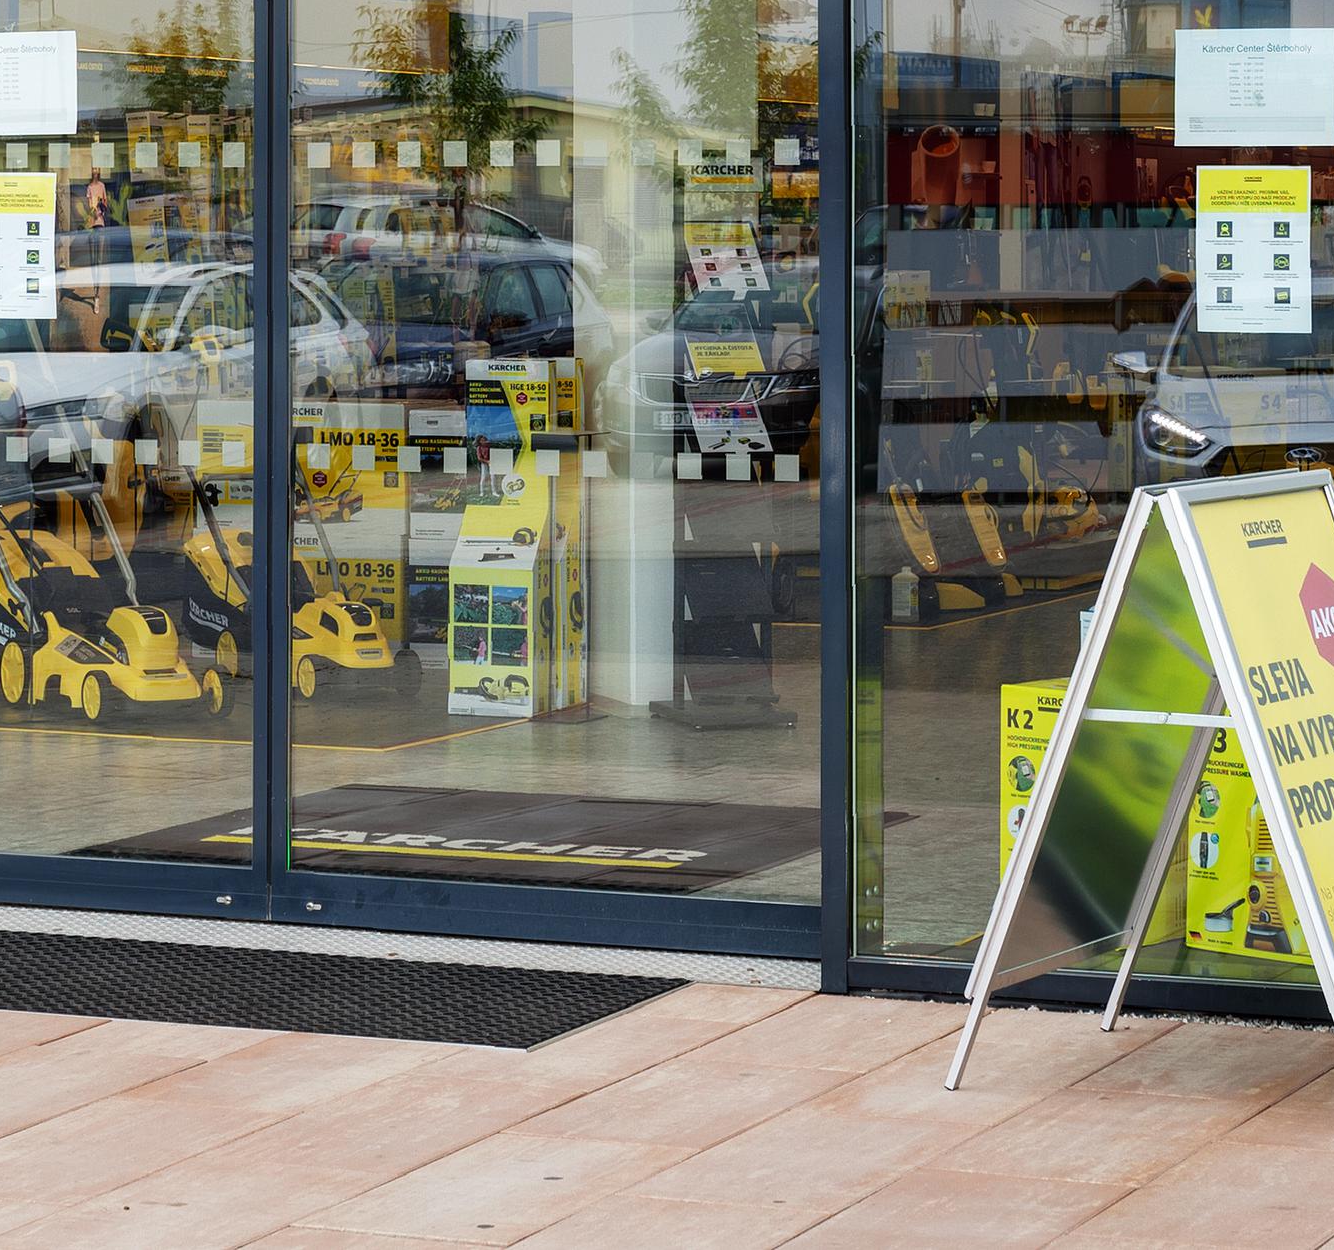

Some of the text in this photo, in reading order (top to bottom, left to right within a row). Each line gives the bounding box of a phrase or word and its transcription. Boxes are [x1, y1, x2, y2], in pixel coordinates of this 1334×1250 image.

[1202, 45, 1234, 53] Kärcher
[1236, 44, 1264, 53] Center
[691, 164, 754, 175] KÄRCHER
[526, 383, 546, 391] 18-50
[293, 408, 323, 416] RCHER
[320, 431, 399, 447] LMO 18-36
[1241, 519, 1284, 537] KÄRCHER
[294, 537, 319, 545] CHER
[355, 563, 395, 578] 18-36
[1249, 658, 1314, 706] SLEVA
[1037, 696, 1063, 706] KÄRC
[1007, 735, 1049, 744] HOCHDRUCKREINIG
[1213, 727, 1227, 753] 3
[1019, 743, 1042, 751] PRESSURE
[1268, 724, 1304, 767] NA
[1208, 759, 1244, 769] RUCKREINIGER
[1320, 886, 1333, 900] Na
